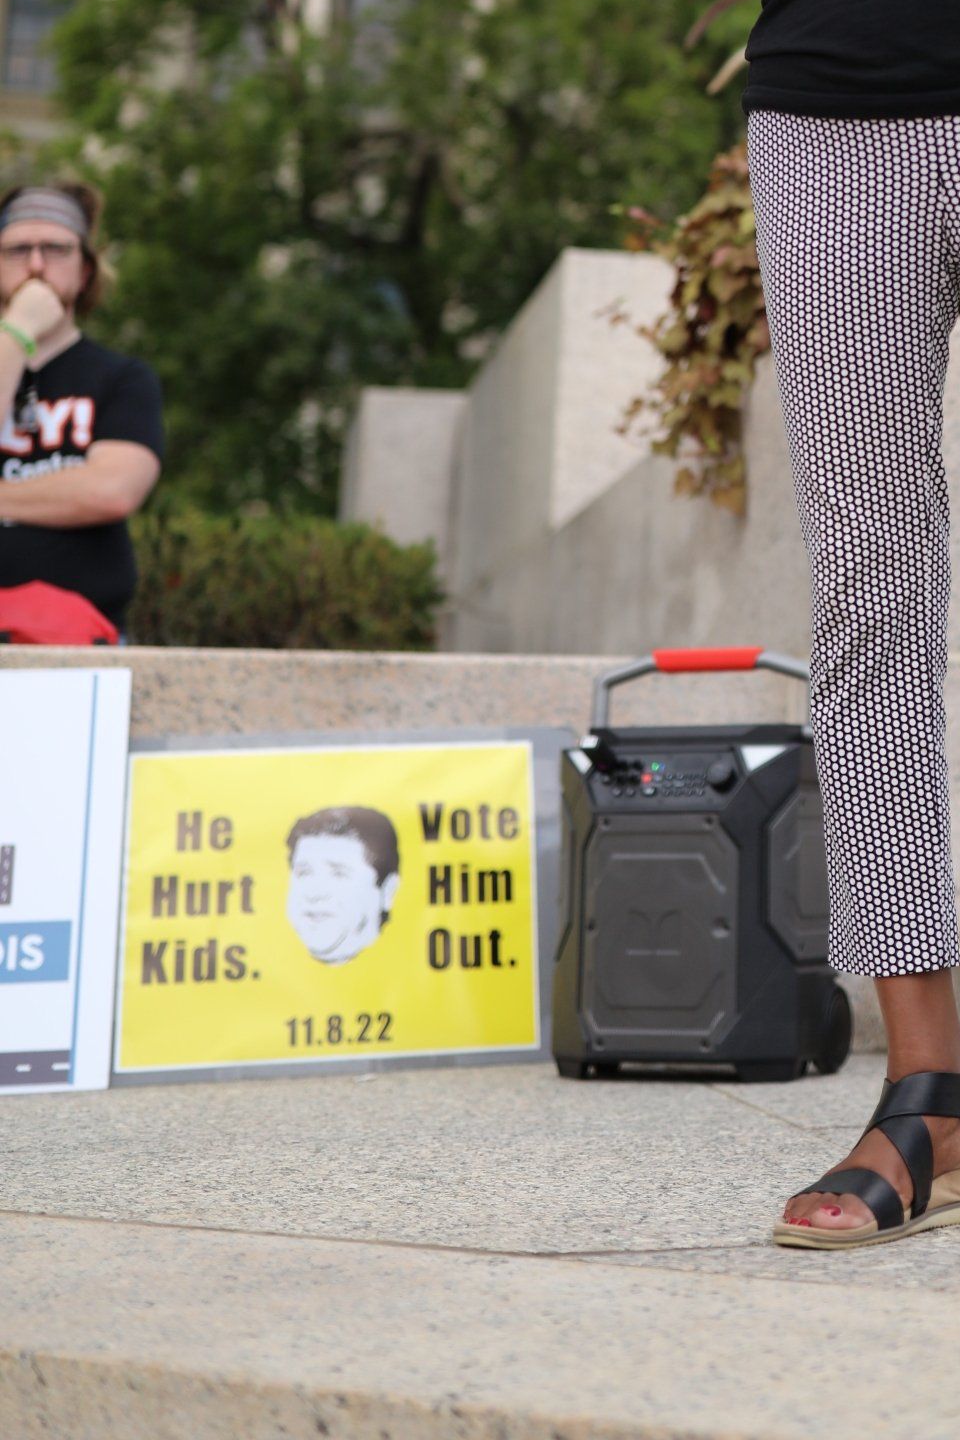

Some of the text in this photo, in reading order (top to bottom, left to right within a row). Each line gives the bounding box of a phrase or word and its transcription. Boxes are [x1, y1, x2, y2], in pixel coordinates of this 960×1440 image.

[176, 810, 234, 852] He
[419, 803, 518, 842] Vote
[152, 874, 254, 918] Hurt
[429, 863, 513, 905] Him
[0, 933, 45, 972] IS
[141, 938, 260, 986] Kids.
[428, 928, 518, 971] Out.
[286, 1012, 394, 1048] 11.8.22
